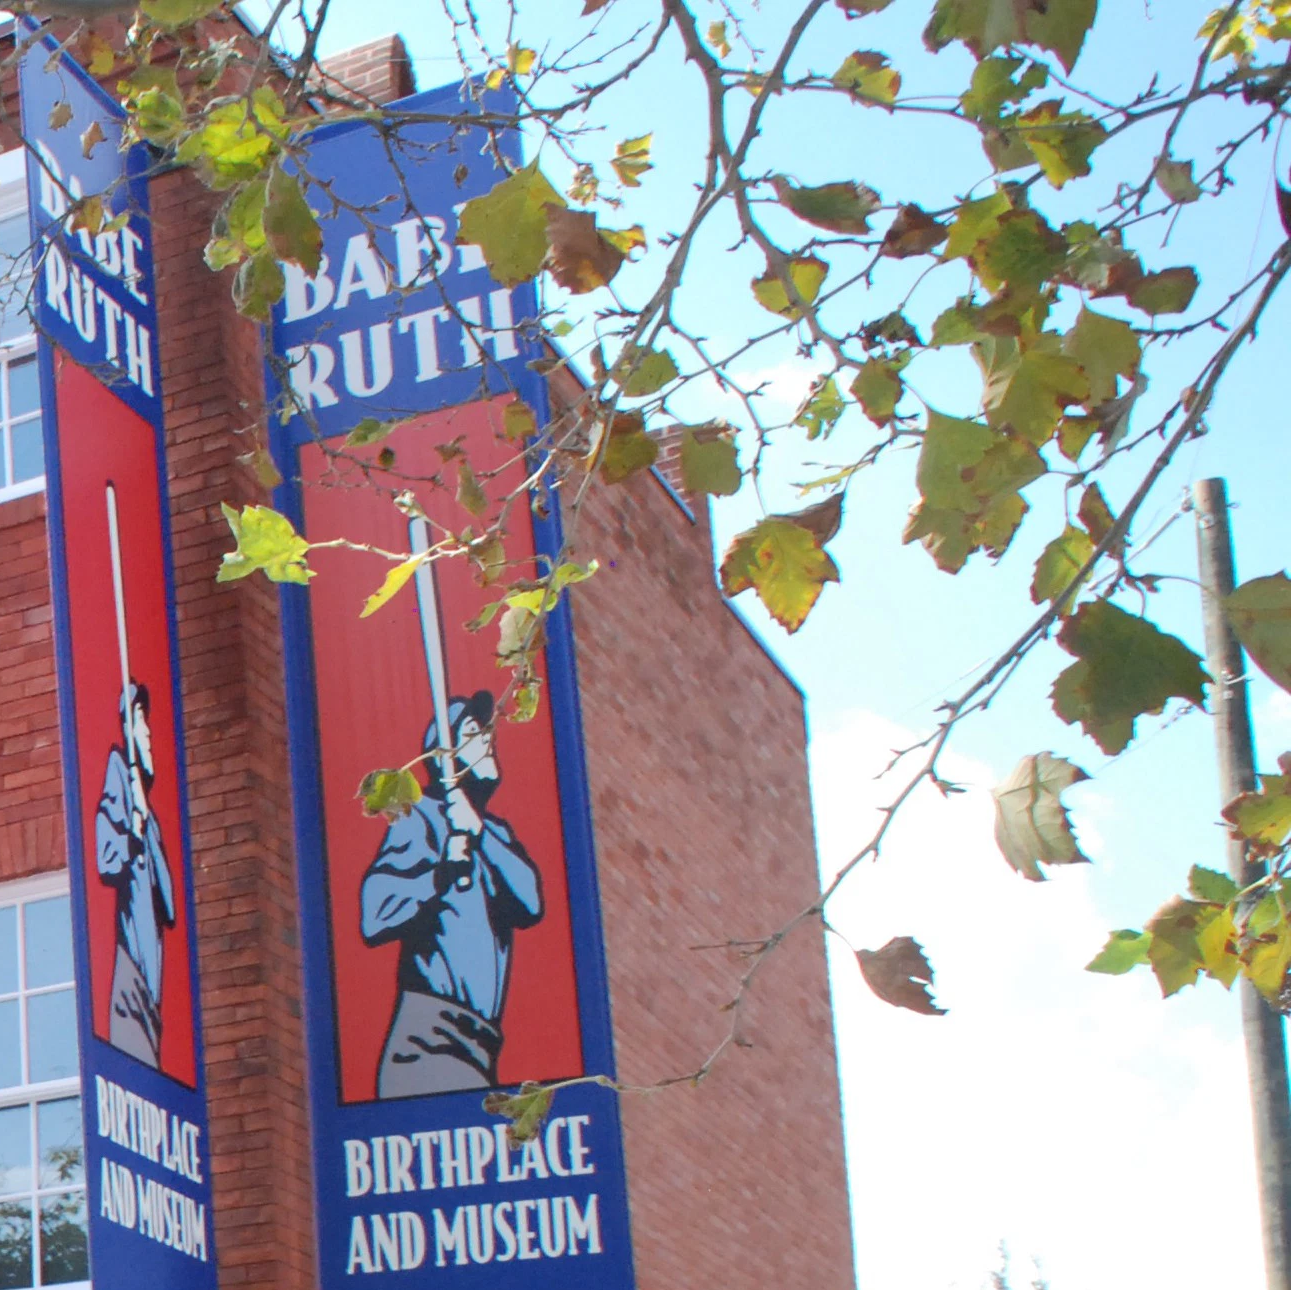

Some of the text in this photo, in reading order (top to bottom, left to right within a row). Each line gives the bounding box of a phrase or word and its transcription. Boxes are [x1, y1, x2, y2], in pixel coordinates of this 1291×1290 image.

[42, 234, 155, 398] RUTH
[277, 287, 520, 416] RUTH
[95, 1073, 204, 1184] BIRTHPLACE
[343, 1114, 595, 1198] BIRTHPLACE
[100, 1156, 208, 1262] AND MUSEUM
[346, 1193, 602, 1275] AND MUSEUM
